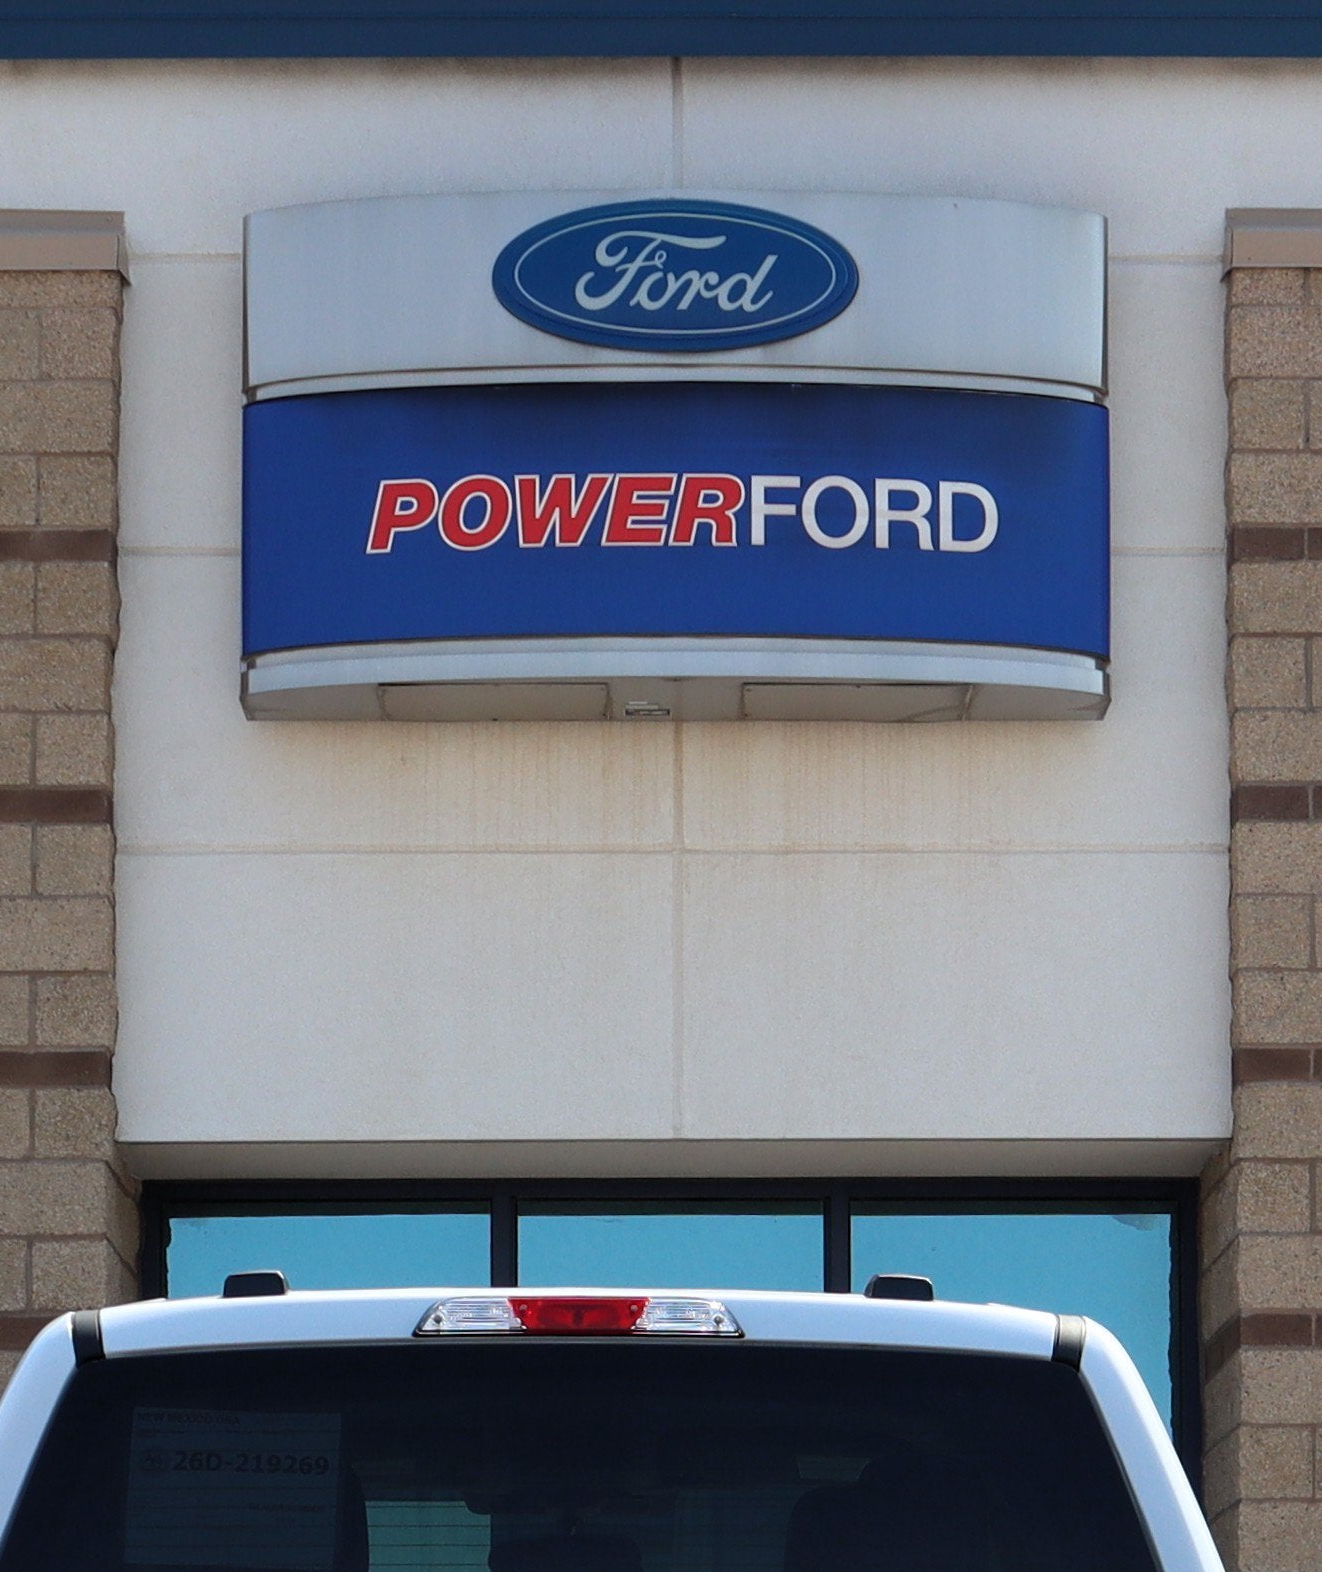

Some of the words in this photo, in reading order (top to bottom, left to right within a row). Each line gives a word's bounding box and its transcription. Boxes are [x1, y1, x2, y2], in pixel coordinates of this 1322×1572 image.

[575, 230, 779, 315] Ford
[366, 472, 999, 555] POWERFORD
[172, 1450, 330, 1476] 26D-219269
